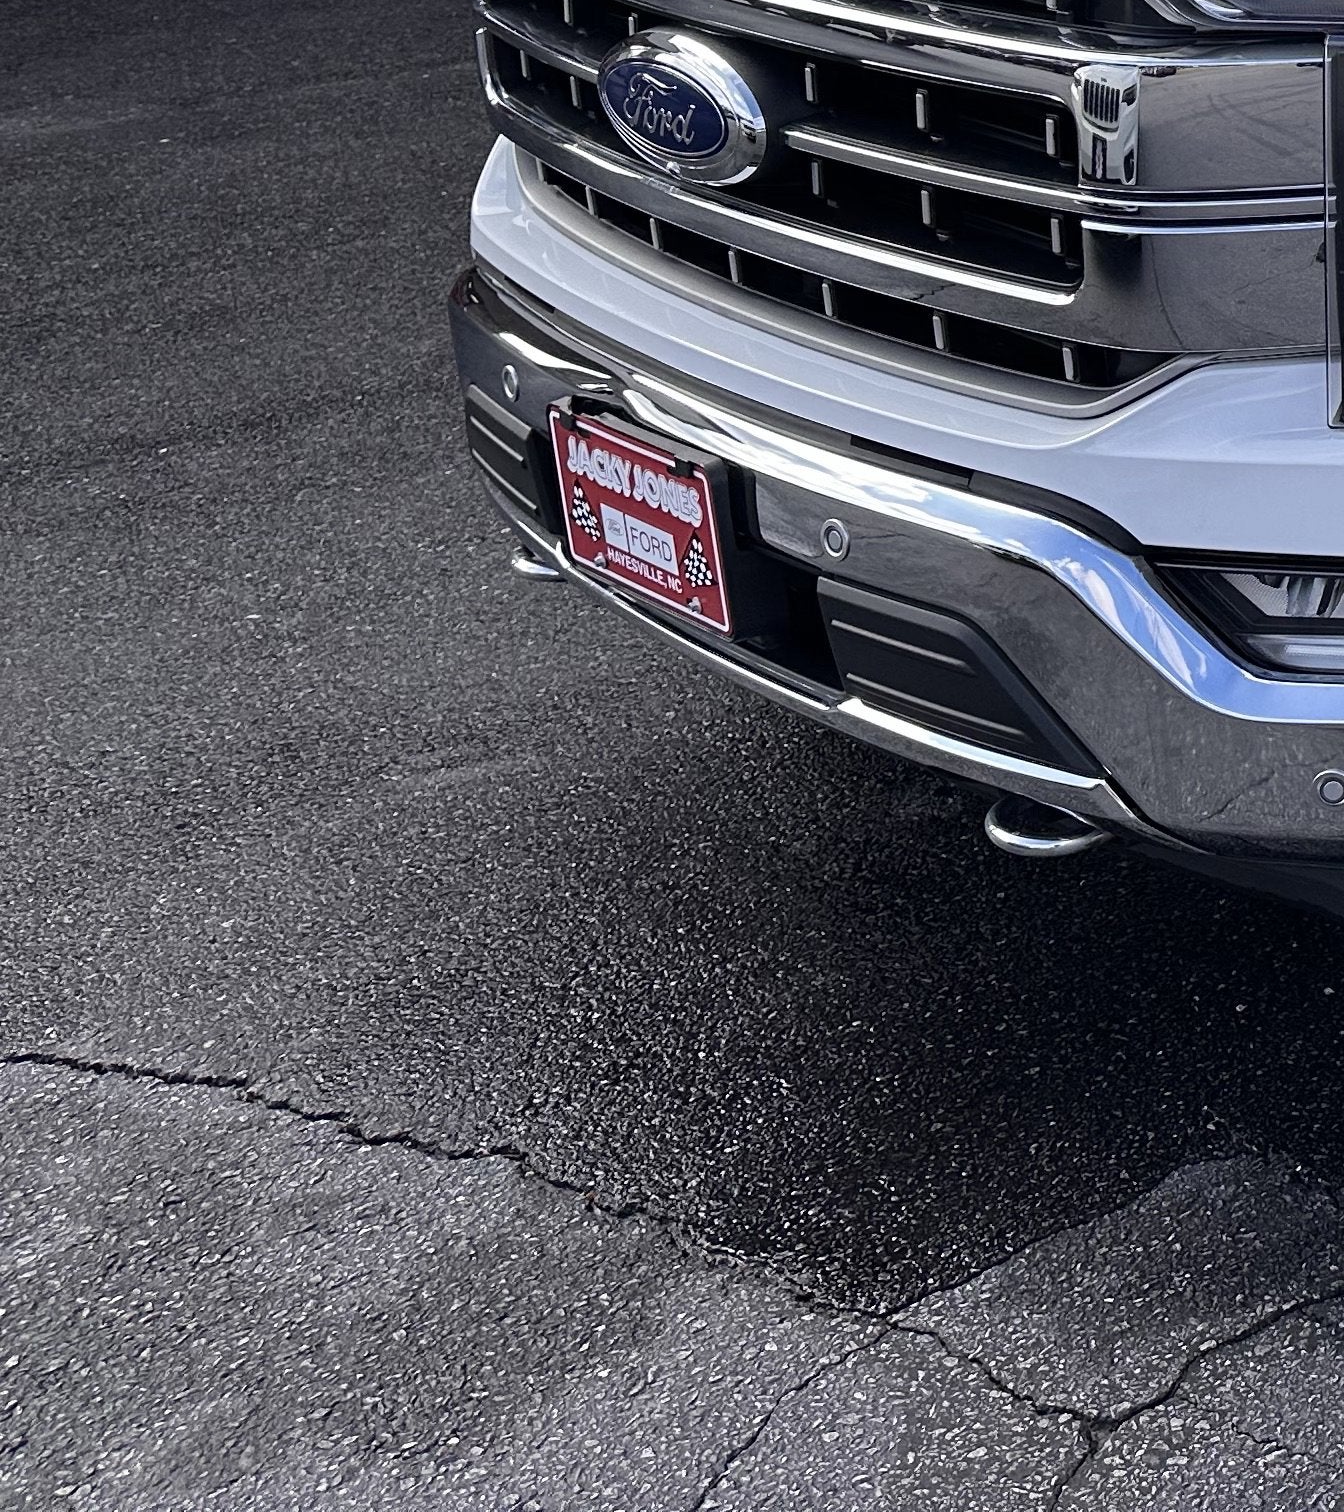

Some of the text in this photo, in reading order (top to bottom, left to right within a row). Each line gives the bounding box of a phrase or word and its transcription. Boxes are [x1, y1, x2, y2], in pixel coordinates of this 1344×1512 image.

[622, 72, 697, 145] Ford
[566, 435, 703, 528] JACKY JONES
[607, 546, 683, 594] HAYESVILLE, NC
[630, 526, 672, 562] FORD
